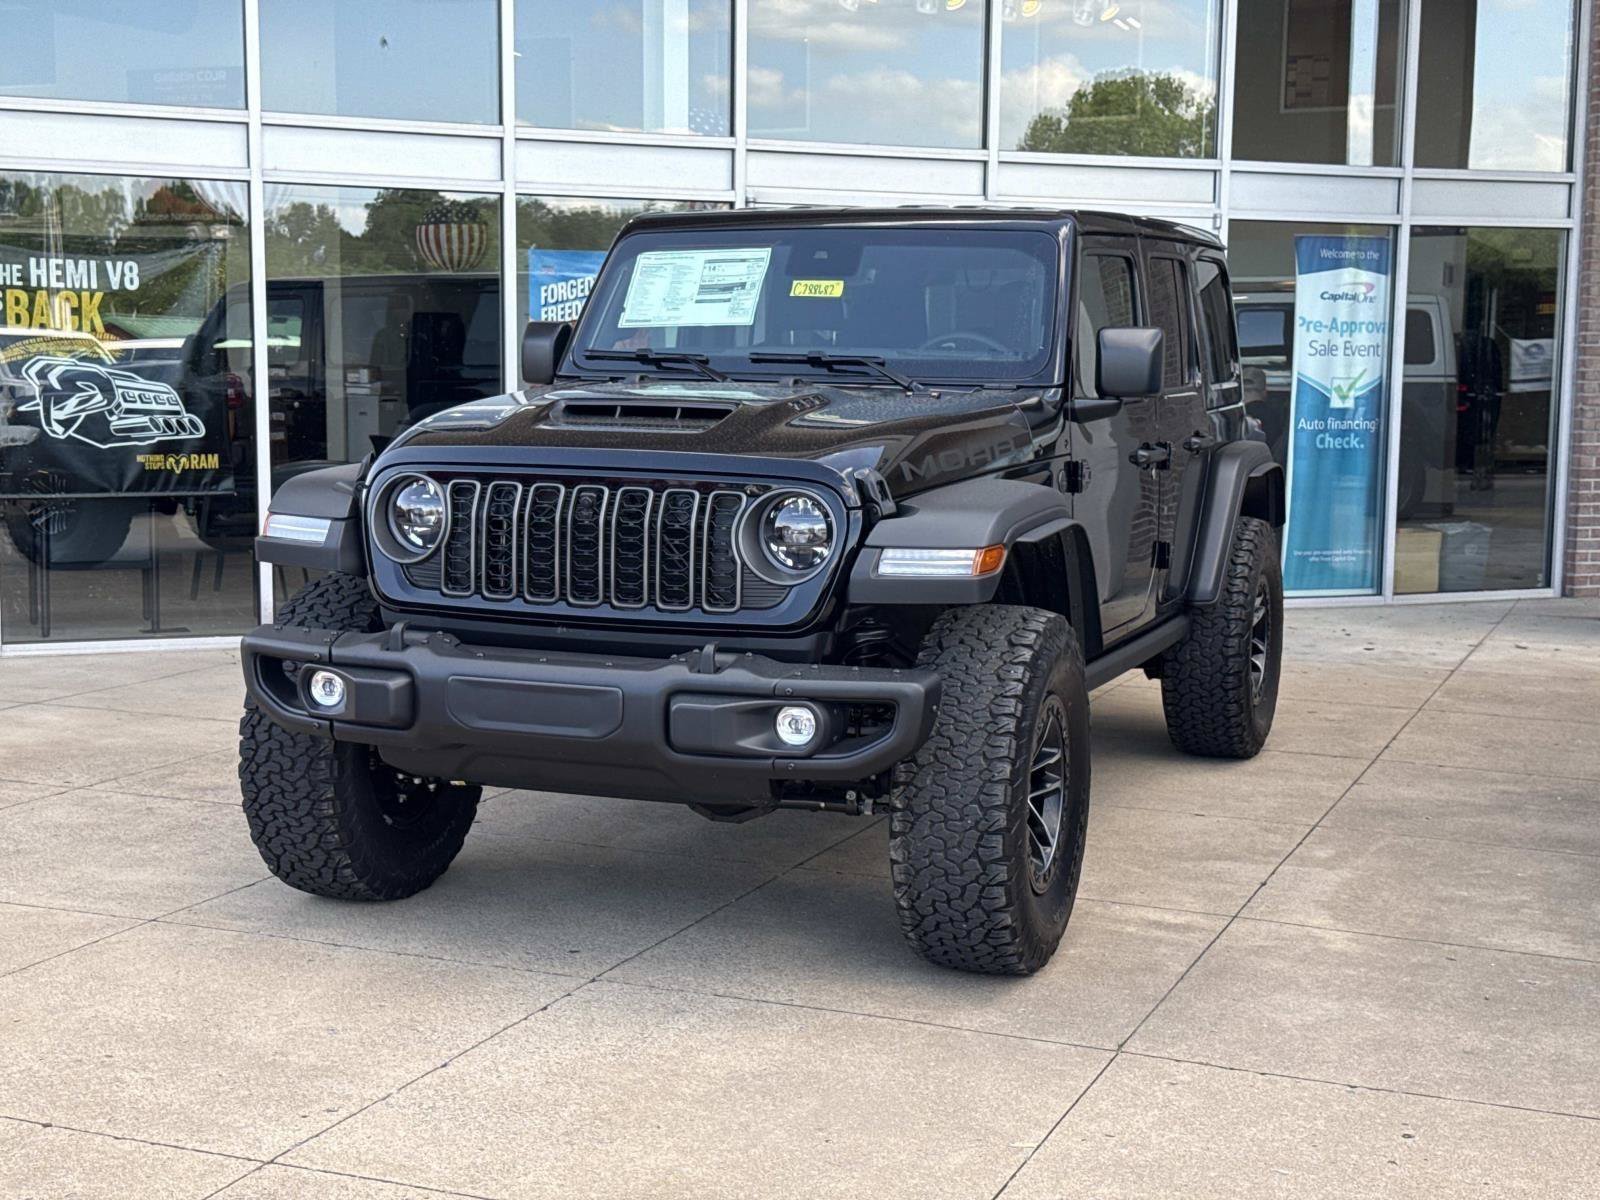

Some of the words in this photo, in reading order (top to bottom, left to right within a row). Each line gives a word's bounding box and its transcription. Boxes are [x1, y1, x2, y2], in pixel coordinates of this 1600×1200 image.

[1320, 248, 1356, 260] Welcome
[1367, 249, 1380, 260] the
[0, 263, 24, 286] HE
[29, 257, 99, 289] HEMI
[105, 260, 140, 291] V8
[540, 276, 595, 306] FORGED
[5, 288, 107, 333] BACK
[540, 300, 587, 322] FREED
[1307, 339, 1338, 357] Sale
[1343, 340, 1381, 358] Event
[1298, 417, 1325, 430] Auto
[1316, 432, 1365, 449] Check.
[190, 453, 219, 470] RAM
